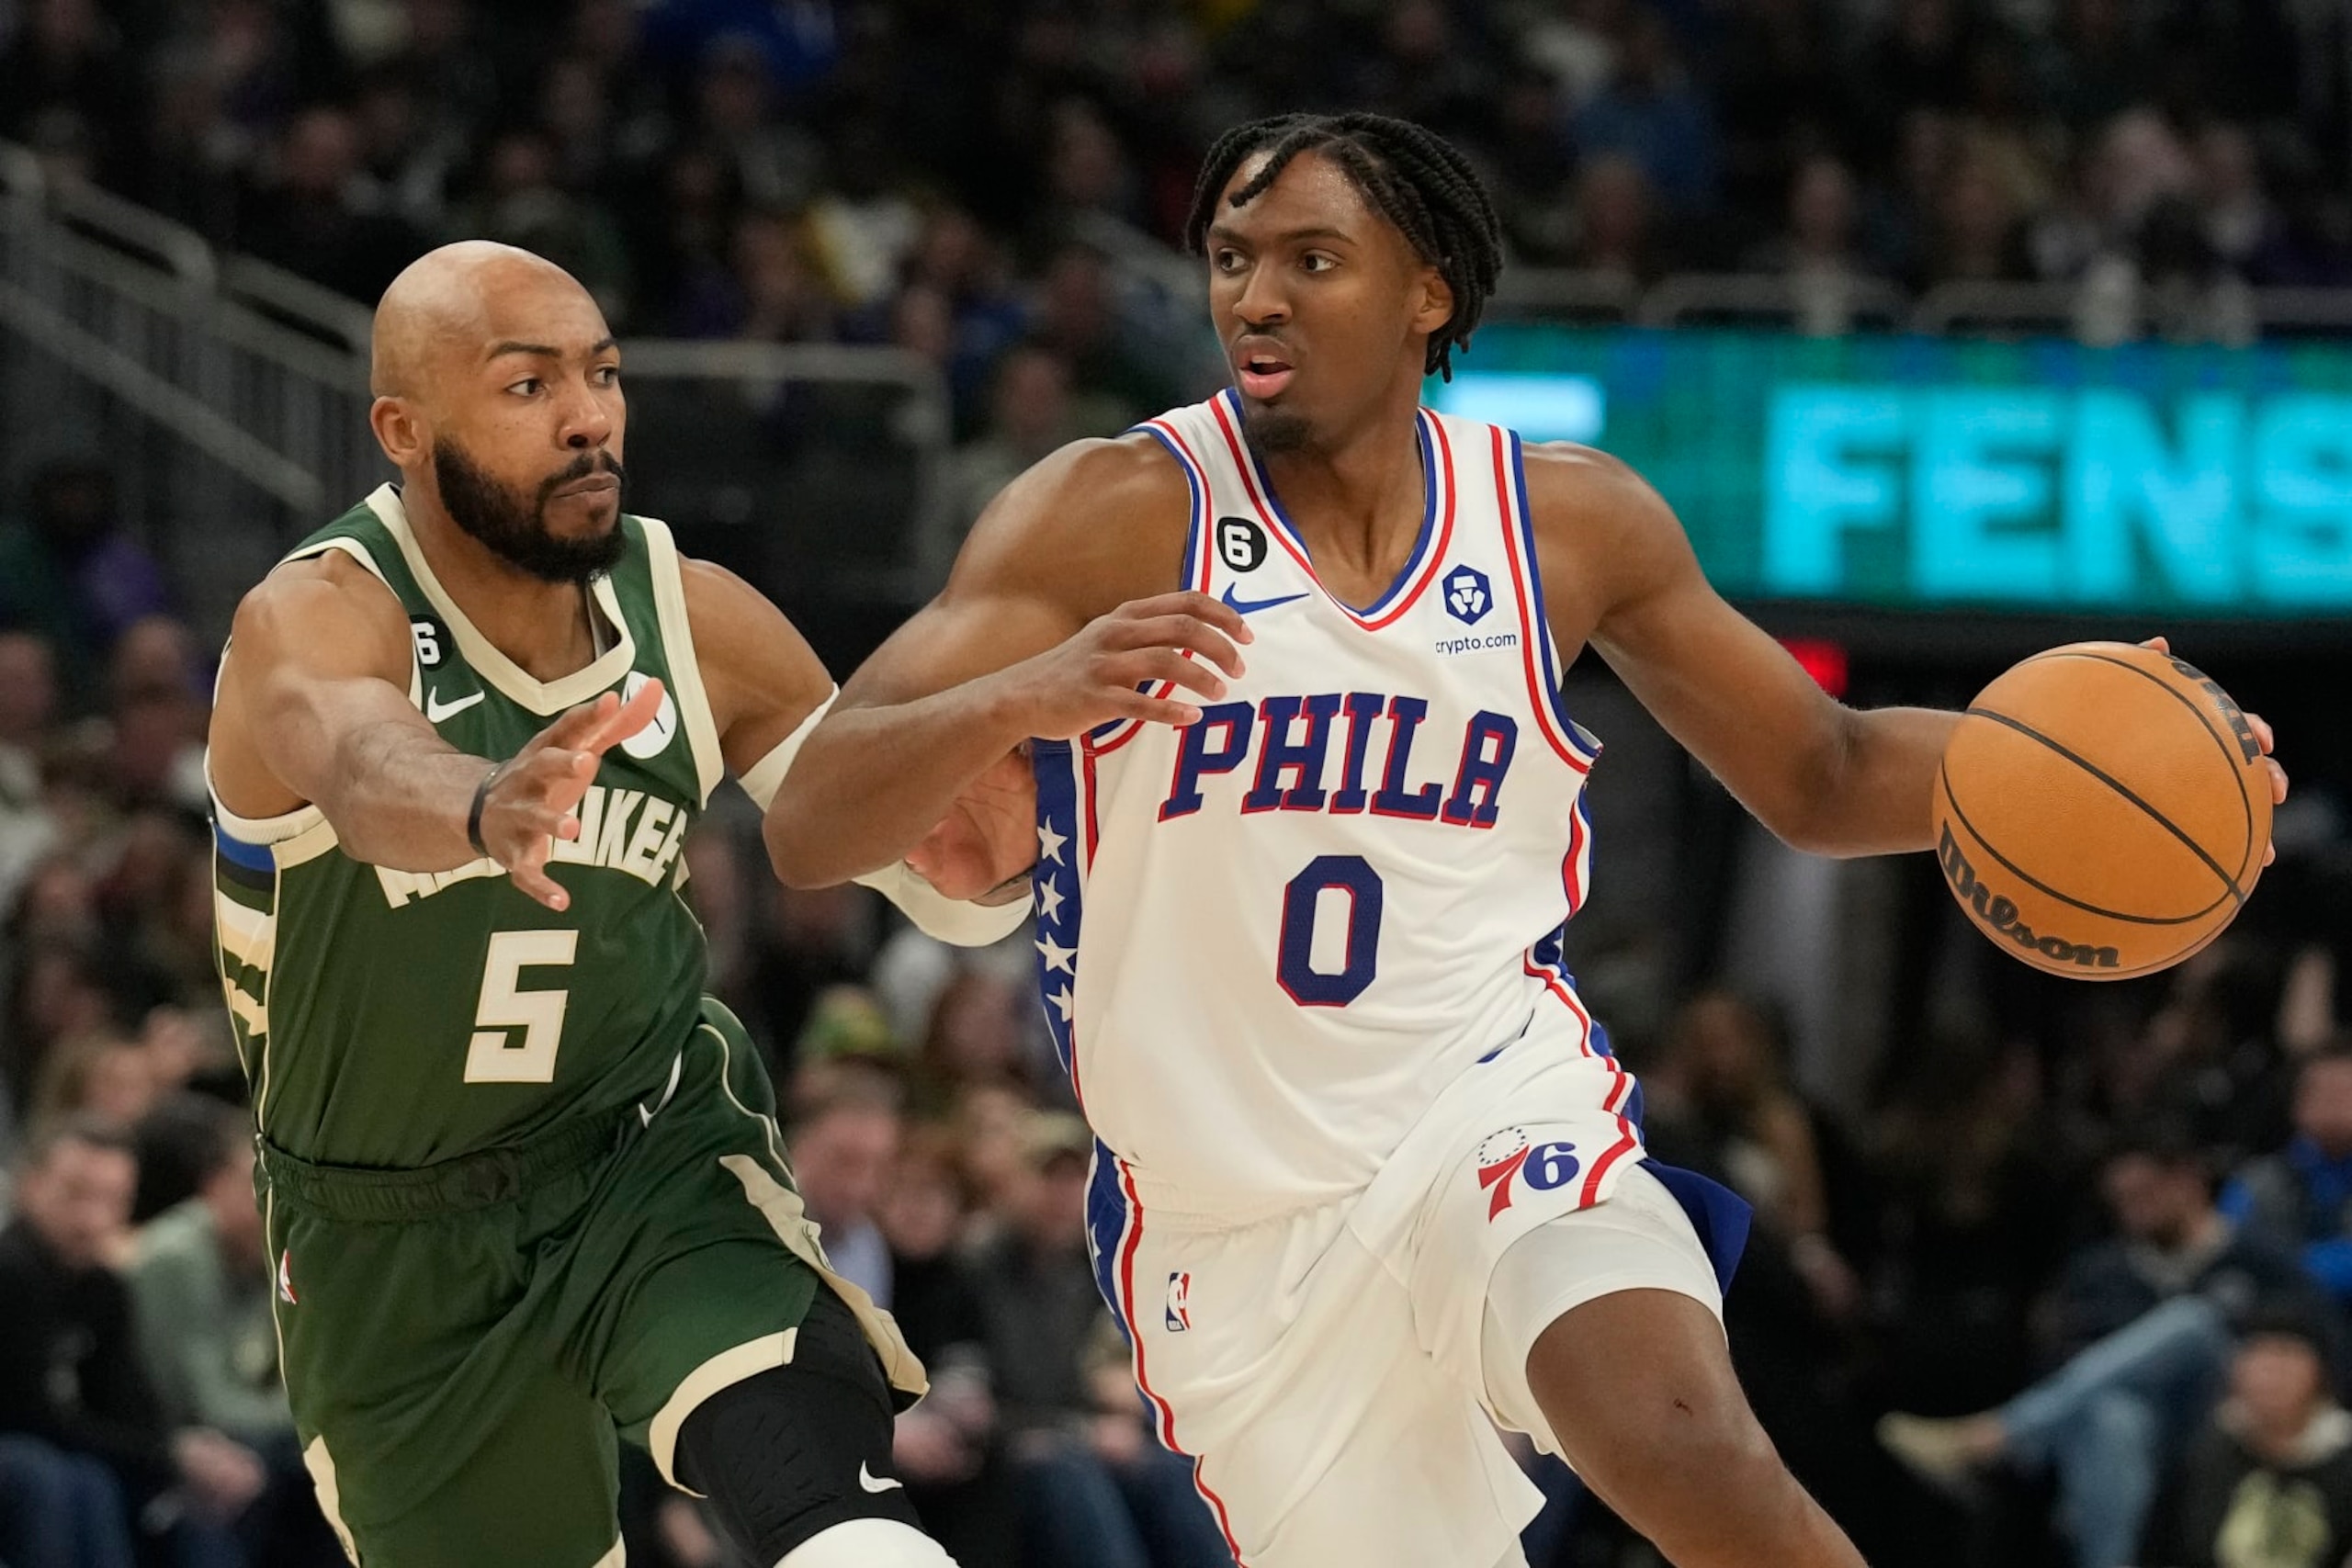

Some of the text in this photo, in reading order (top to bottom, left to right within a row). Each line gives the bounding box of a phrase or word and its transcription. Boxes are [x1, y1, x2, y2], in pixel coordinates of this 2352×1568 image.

[1224, 524, 1253, 567] 6
[1762, 388, 2352, 599] FENS
[411, 622, 441, 664] 6
[1435, 634, 1518, 656] crypto.com
[1158, 692, 1519, 829] PHILA
[1276, 854, 1384, 1009] 0
[1939, 817, 2120, 968] Wilson
[463, 929, 580, 1084] 5
[1477, 1142, 1580, 1224] 76
